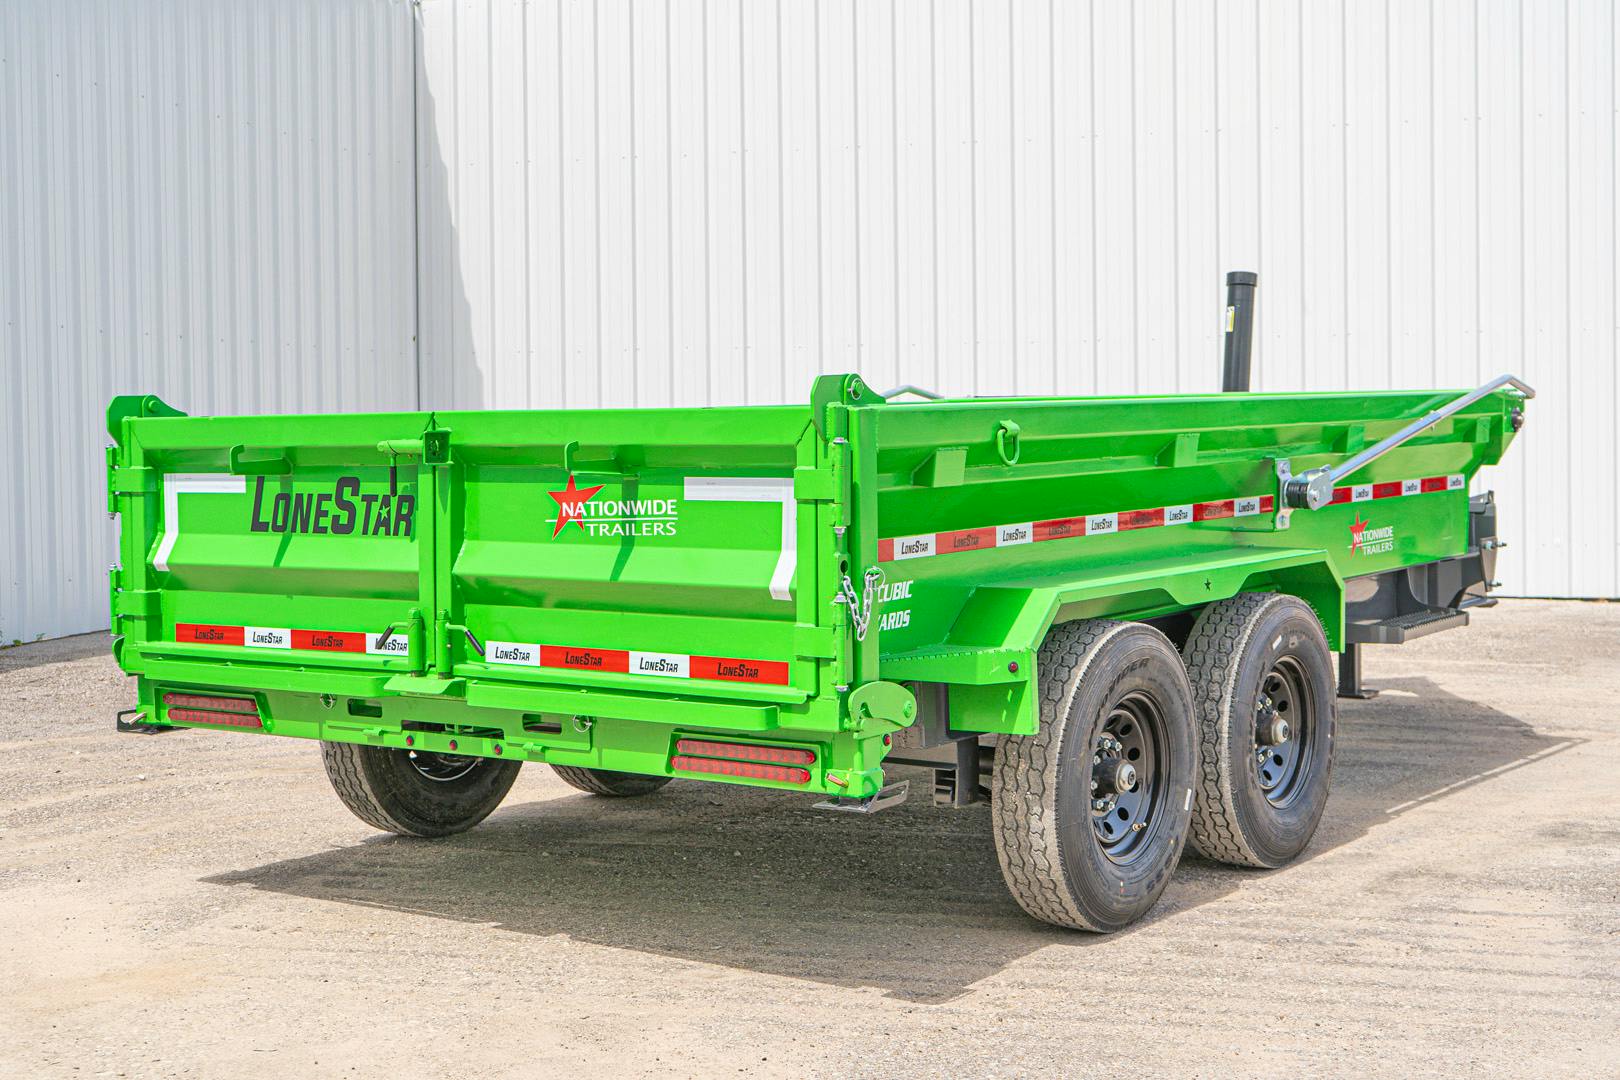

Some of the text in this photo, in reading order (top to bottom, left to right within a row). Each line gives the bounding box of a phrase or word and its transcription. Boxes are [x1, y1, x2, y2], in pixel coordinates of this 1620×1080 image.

[562, 499, 678, 517] NATIONWIDE
[586, 522, 677, 537] TRAILERS
[1353, 526, 1393, 543] NATIONWIDE
[1363, 541, 1393, 555] TRAILERS
[878, 580, 913, 603] CUBIC
[878, 610, 911, 631] ARDS
[375, 638, 408, 652] NESTAR
